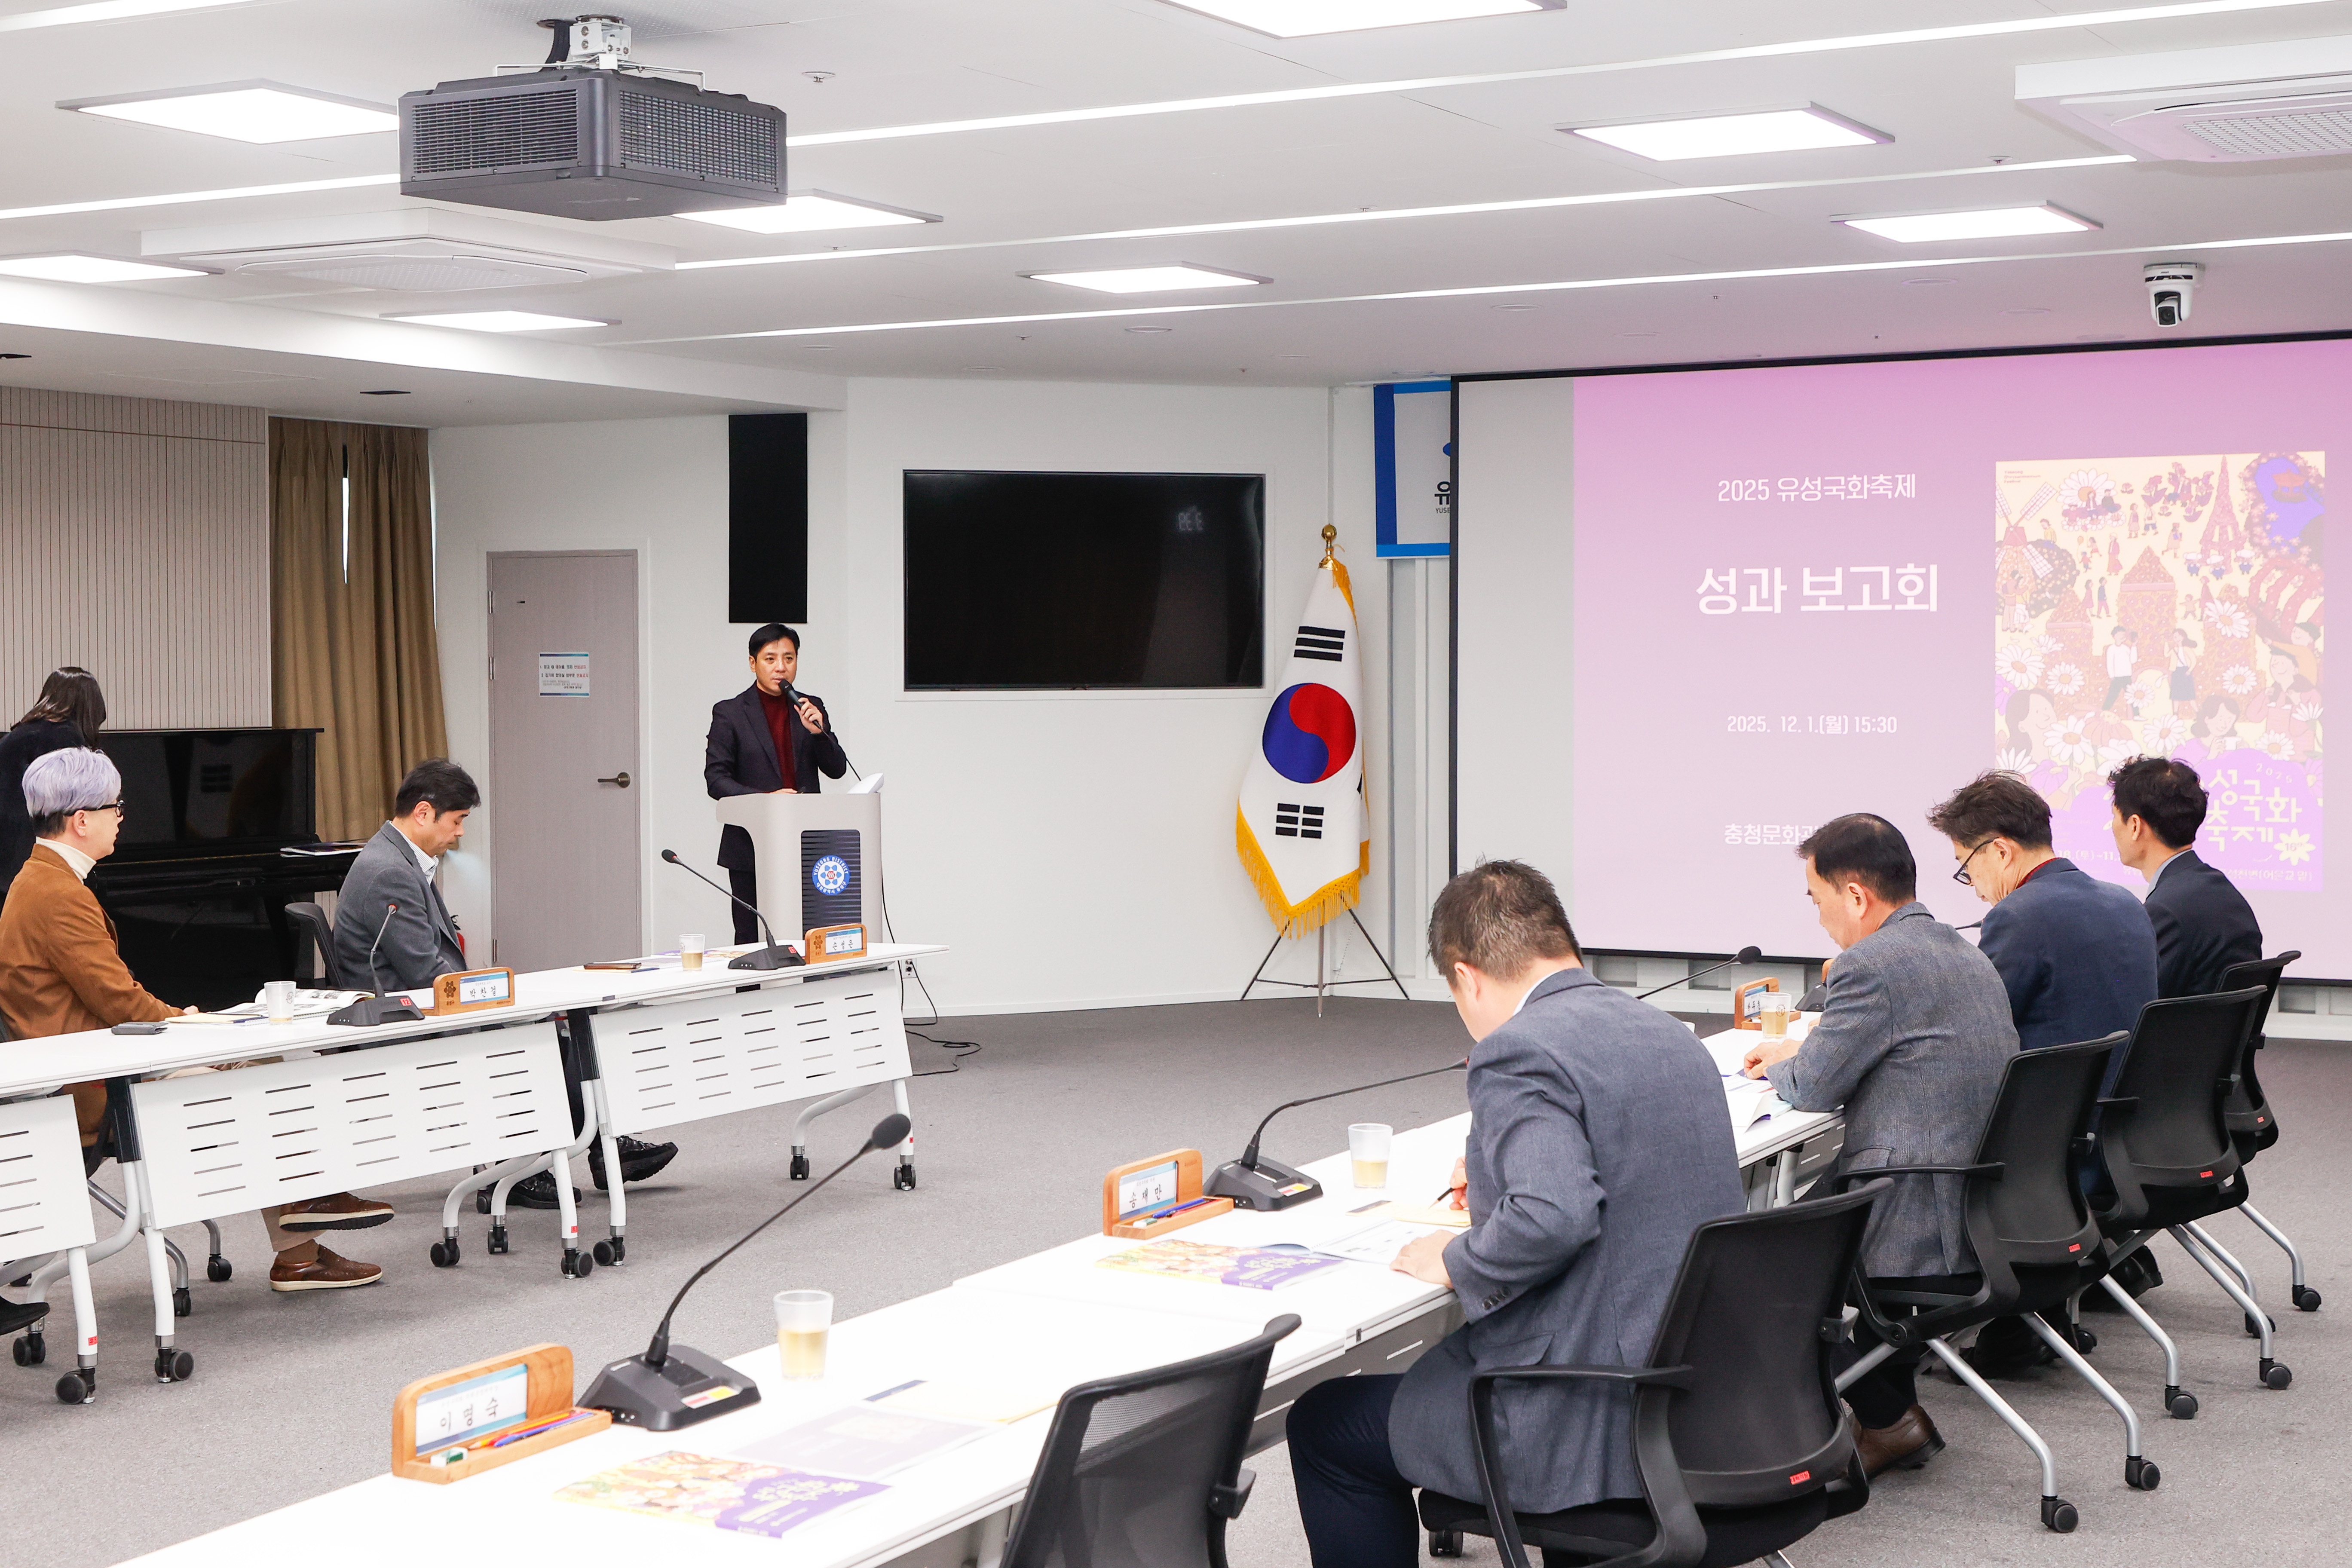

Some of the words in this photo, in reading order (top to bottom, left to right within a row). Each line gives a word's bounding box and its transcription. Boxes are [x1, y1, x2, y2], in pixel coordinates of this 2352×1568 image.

[1718, 478, 1770, 502] 2025
[1776, 473, 1916, 502] 유성국화축제
[1696, 567, 1787, 615] 성과
[1800, 563, 1937, 612] 보고회
[1727, 715, 1770, 732] 2025.
[1854, 715, 1898, 733] 15:30
[2205, 799, 2274, 852] 축제
[814, 857, 830, 876] YUSEONG
[832, 857, 848, 874] DISTRICT
[832, 940, 853, 951] 손성은
[1129, 1184, 1162, 1209] 송재만
